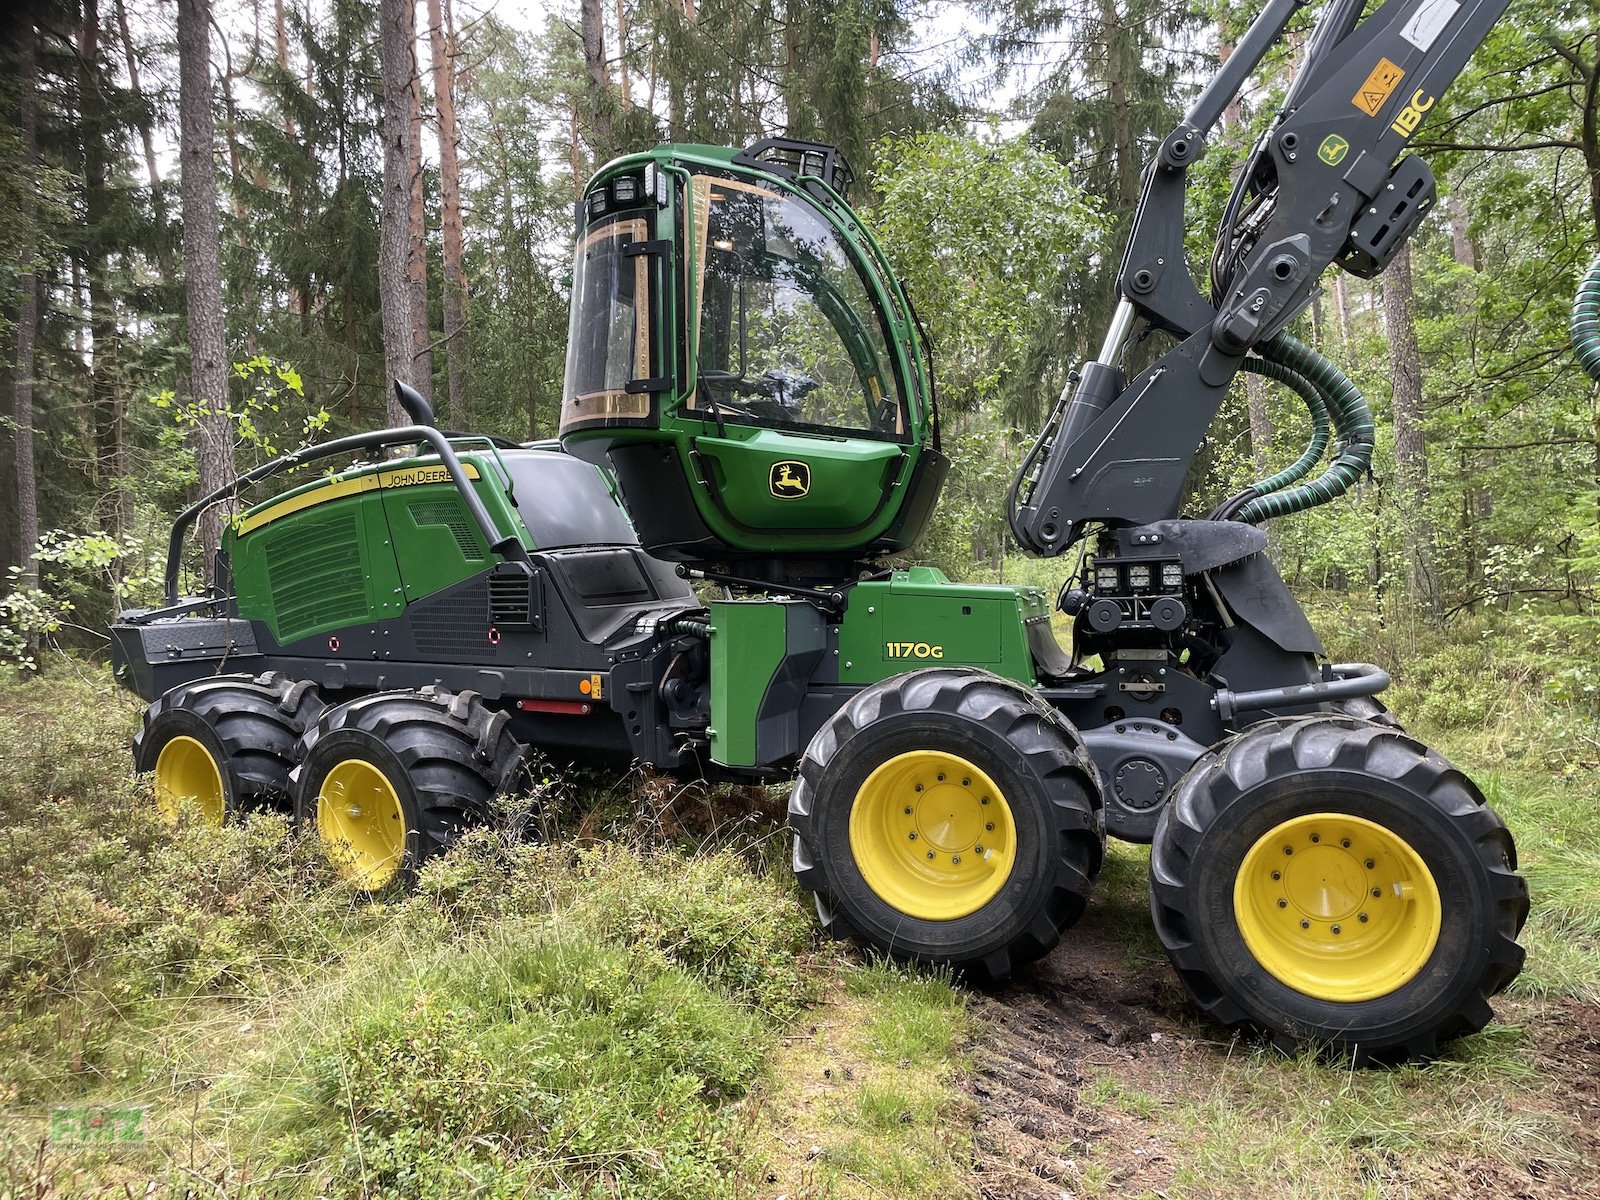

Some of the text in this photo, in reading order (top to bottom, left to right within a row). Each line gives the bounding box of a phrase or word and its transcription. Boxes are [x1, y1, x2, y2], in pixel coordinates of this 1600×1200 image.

[1391, 88, 1435, 138] IBC
[388, 473, 415, 488] JOHN
[886, 641, 944, 659] 1170G
